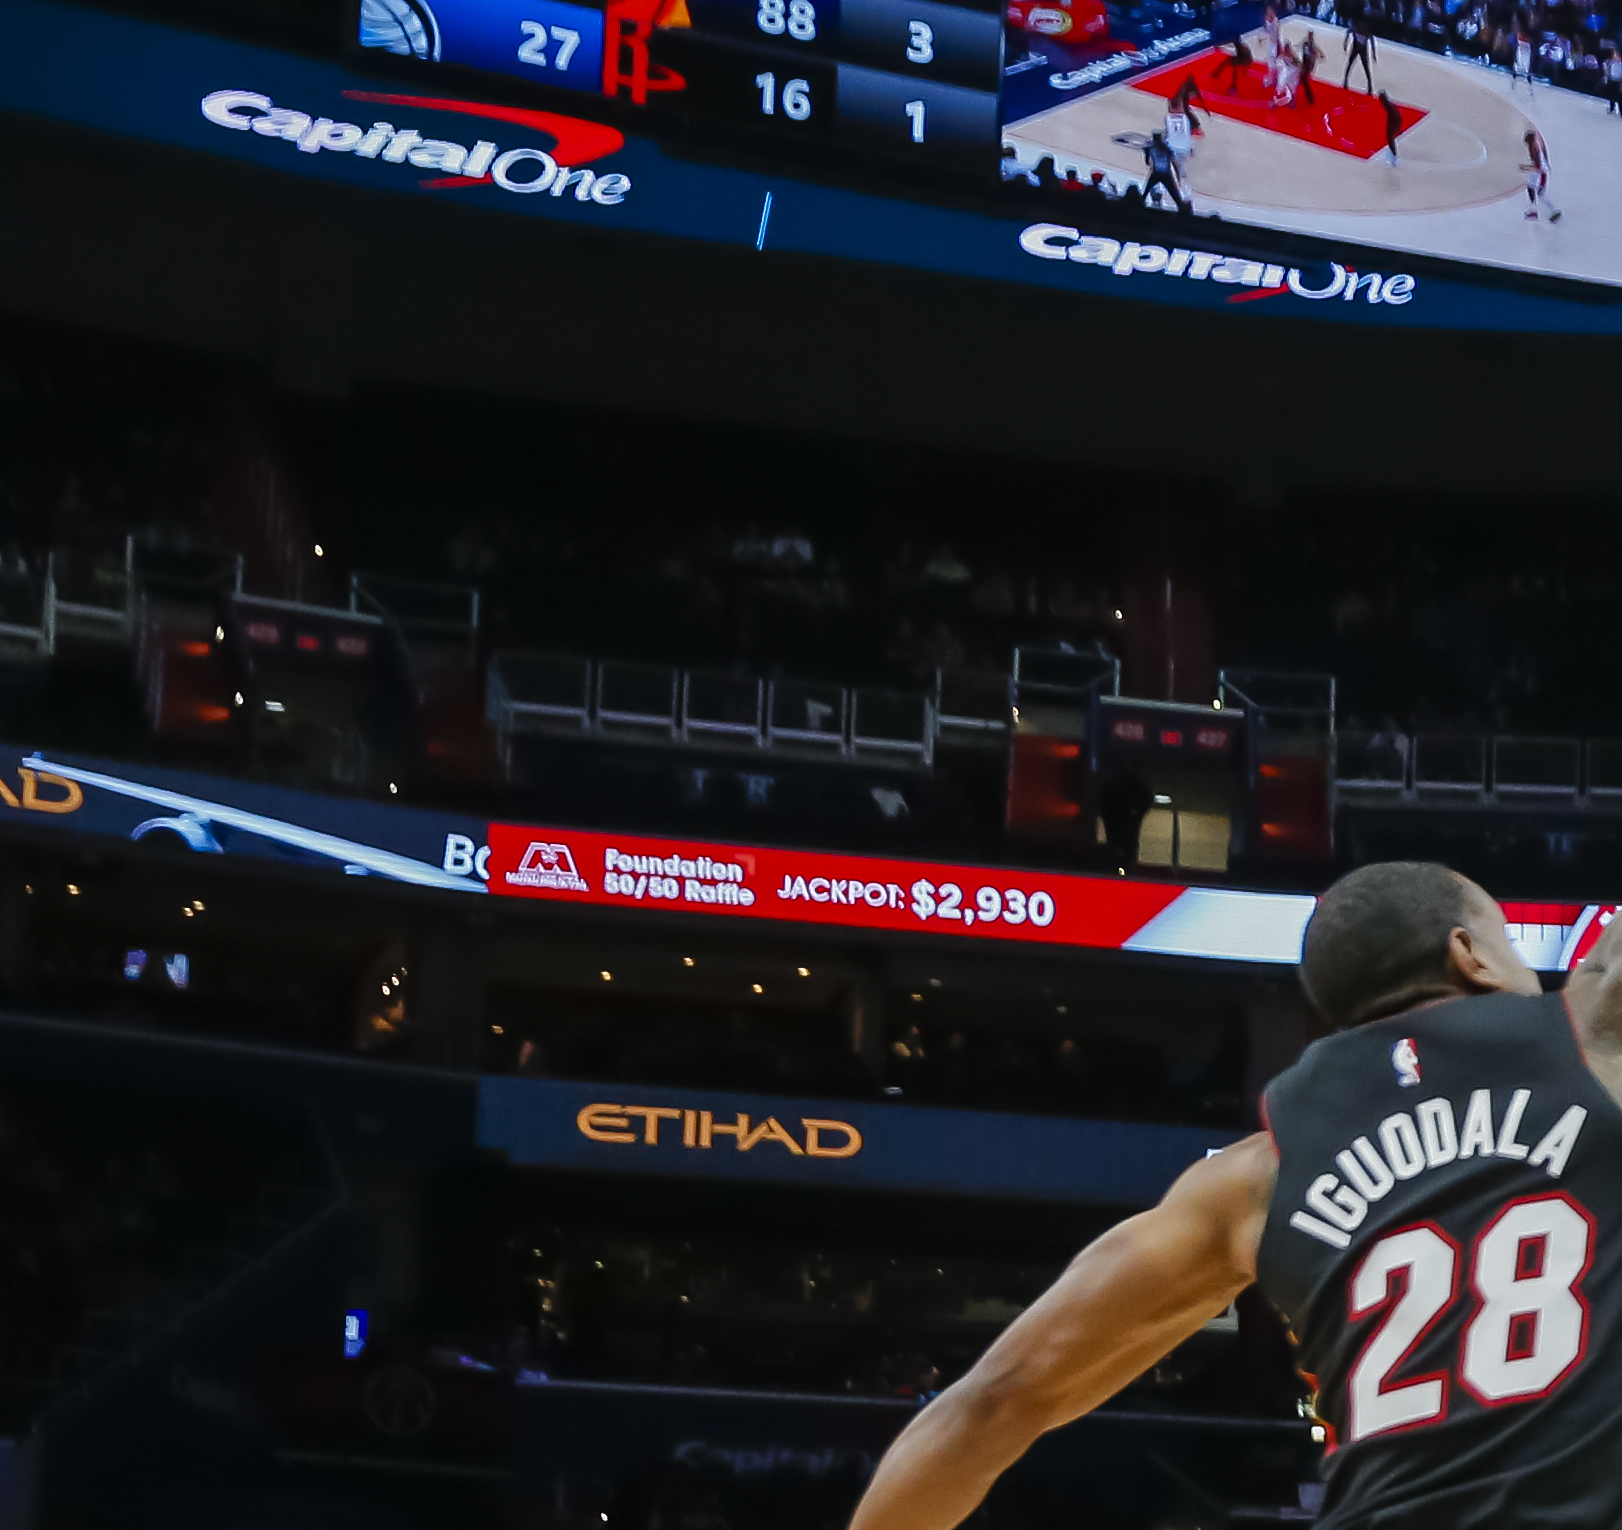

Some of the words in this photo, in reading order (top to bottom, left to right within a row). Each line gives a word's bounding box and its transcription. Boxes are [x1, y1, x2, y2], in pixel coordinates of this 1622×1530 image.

[516, 20, 582, 71] 27
[756, 0, 816, 41] 88
[905, 20, 934, 64] 3
[755, 72, 812, 121] 16
[904, 100, 926, 144] 1
[602, 870, 680, 901] 50/50
[684, 879, 755, 908] Raffle
[603, 847, 744, 883] Foundation
[910, 878, 1056, 928] $2,930
[577, 1101, 863, 1159] ETIHAD
[1289, 1087, 1588, 1250] IGUODALA
[1346, 1188, 1598, 1443] 28
